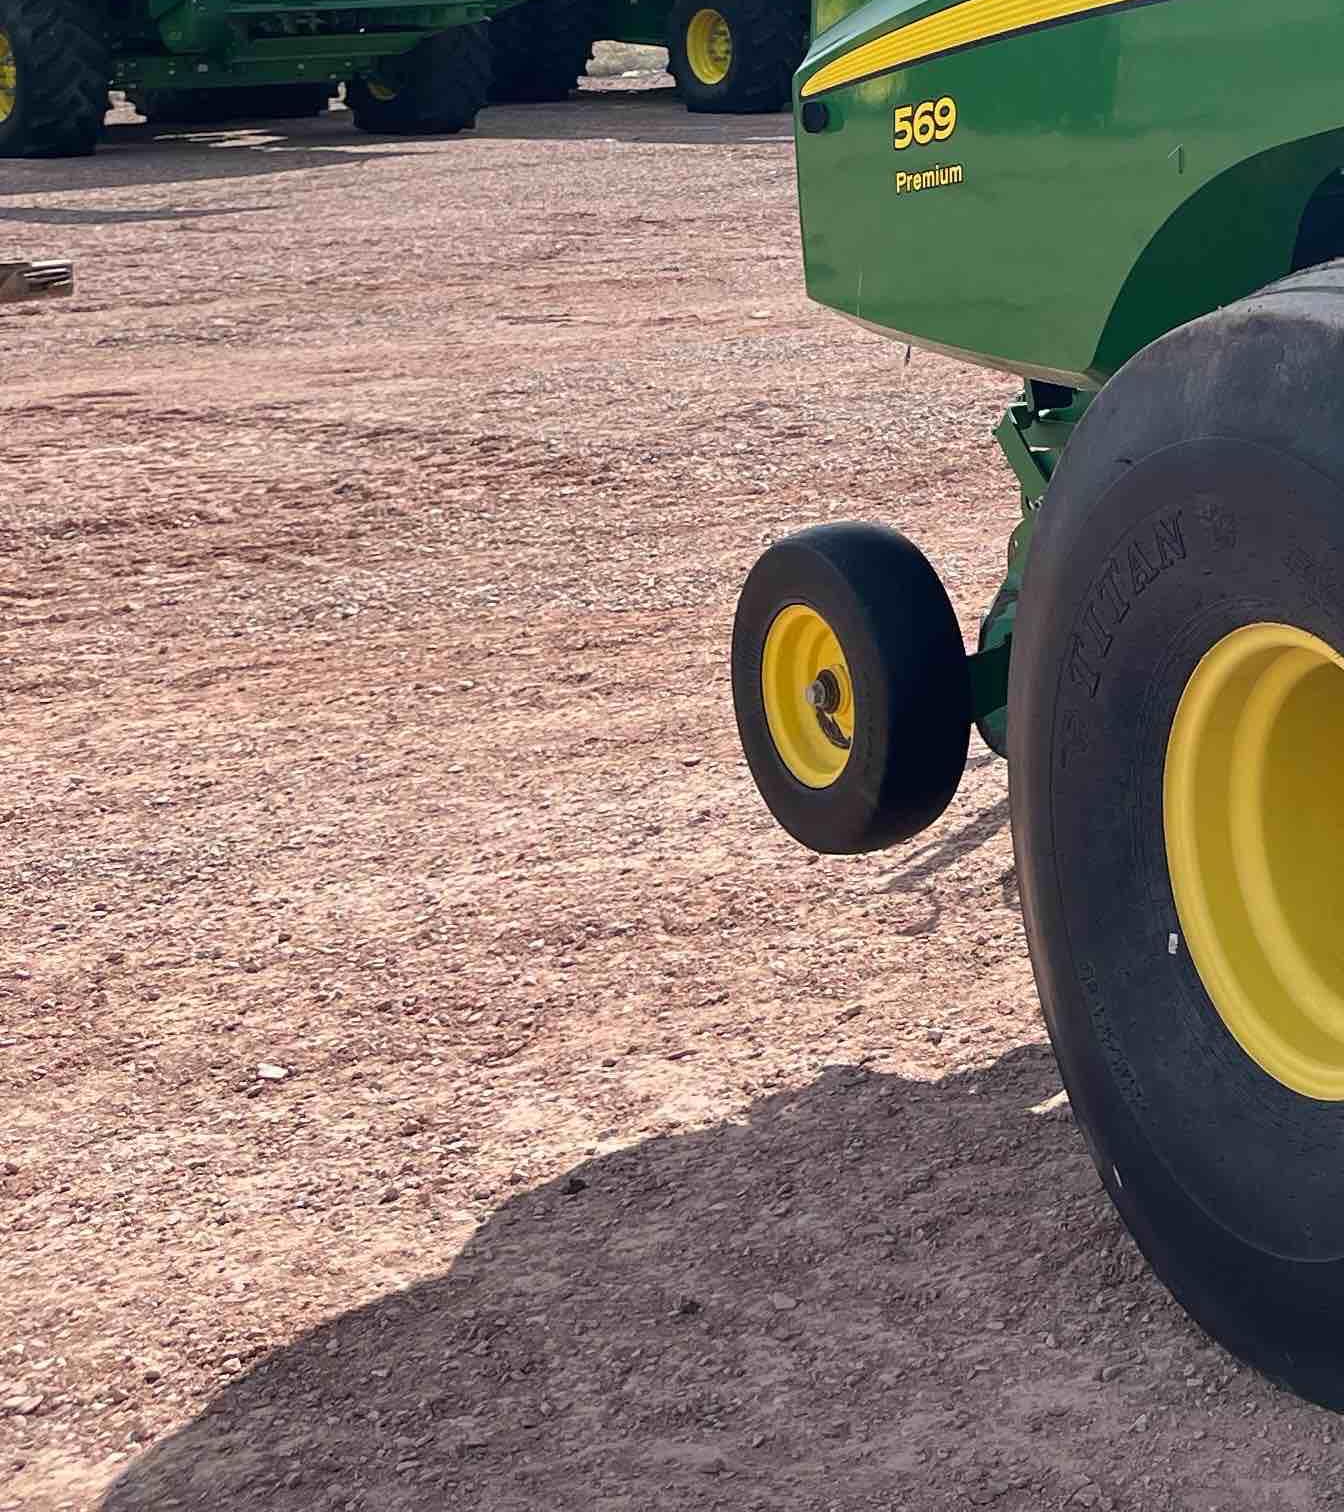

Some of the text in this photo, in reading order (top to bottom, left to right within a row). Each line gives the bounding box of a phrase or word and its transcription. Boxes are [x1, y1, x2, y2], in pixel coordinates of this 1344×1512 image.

[893, 96, 957, 150] 569
[895, 164, 963, 194] Premium
[1067, 508, 1187, 700] TITAN
